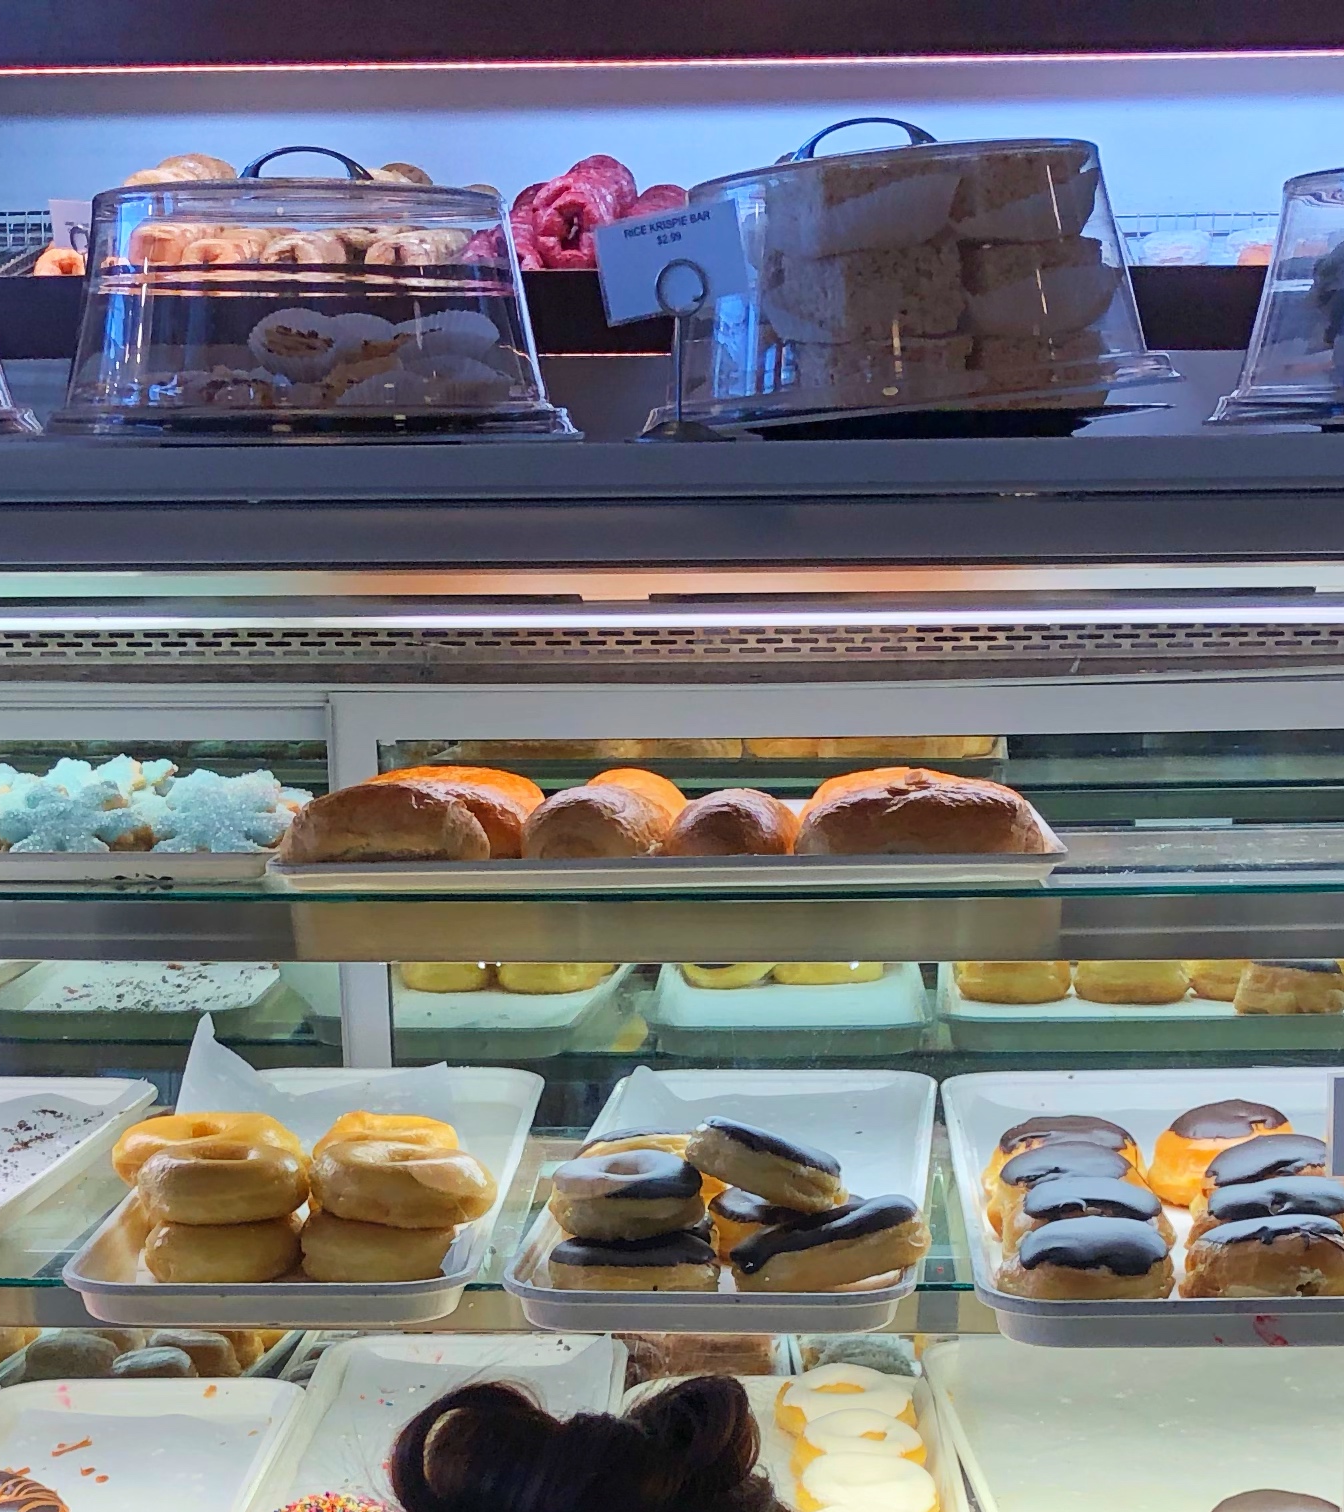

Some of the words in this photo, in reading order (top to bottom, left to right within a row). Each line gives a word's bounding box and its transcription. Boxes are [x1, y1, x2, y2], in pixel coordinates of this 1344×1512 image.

[623, 224, 647, 239] RICE
[649, 214, 688, 233] KRISPIE
[689, 210, 711, 223] BAR
[656, 231, 682, 245] $2.99
